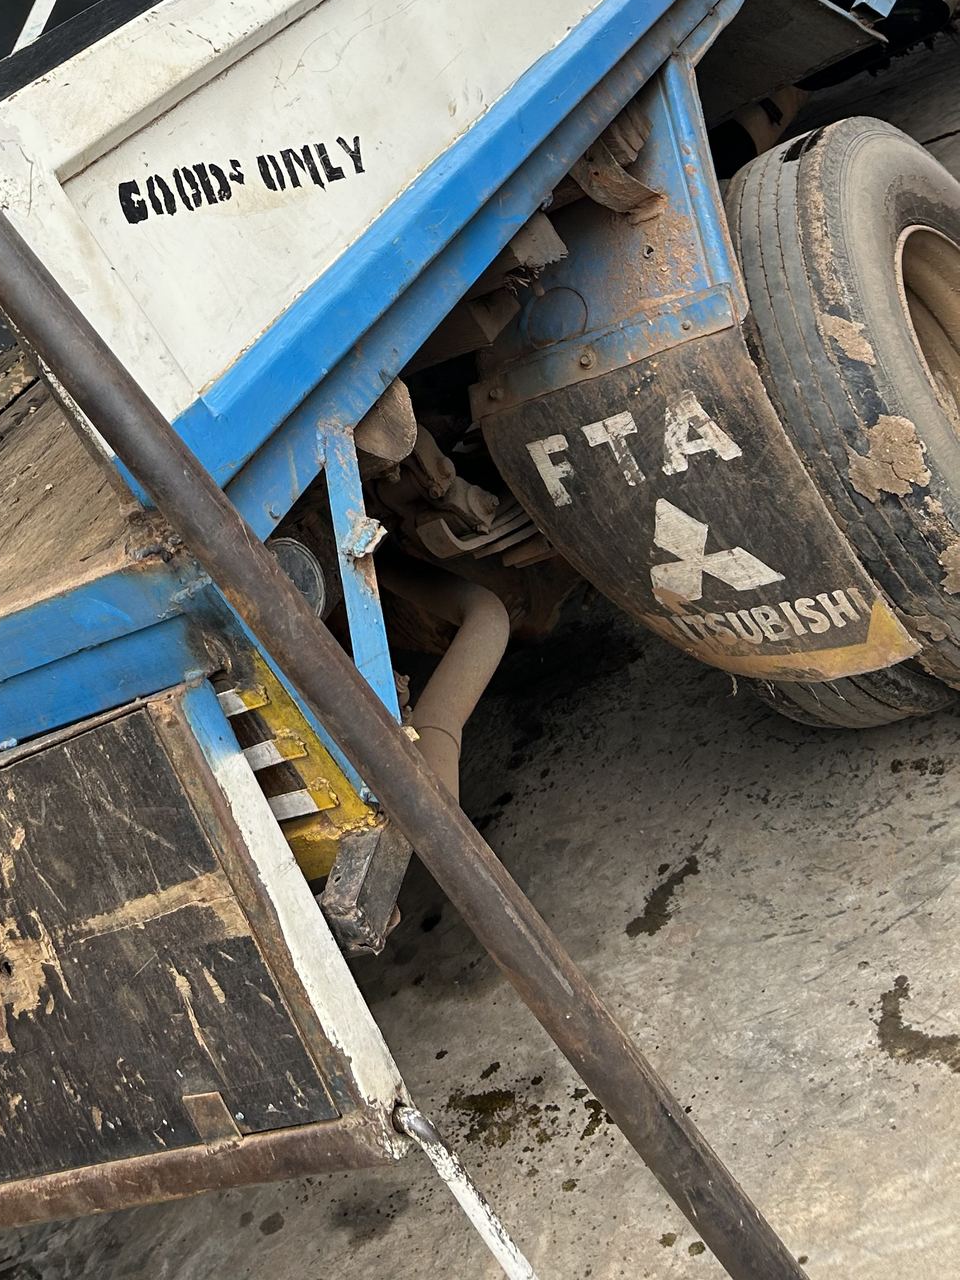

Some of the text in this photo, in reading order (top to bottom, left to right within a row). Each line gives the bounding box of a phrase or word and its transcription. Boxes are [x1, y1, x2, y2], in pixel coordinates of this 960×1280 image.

[118, 136, 366, 224] GOODS ONLY
[671, 587, 873, 646] ITSUBISHI
